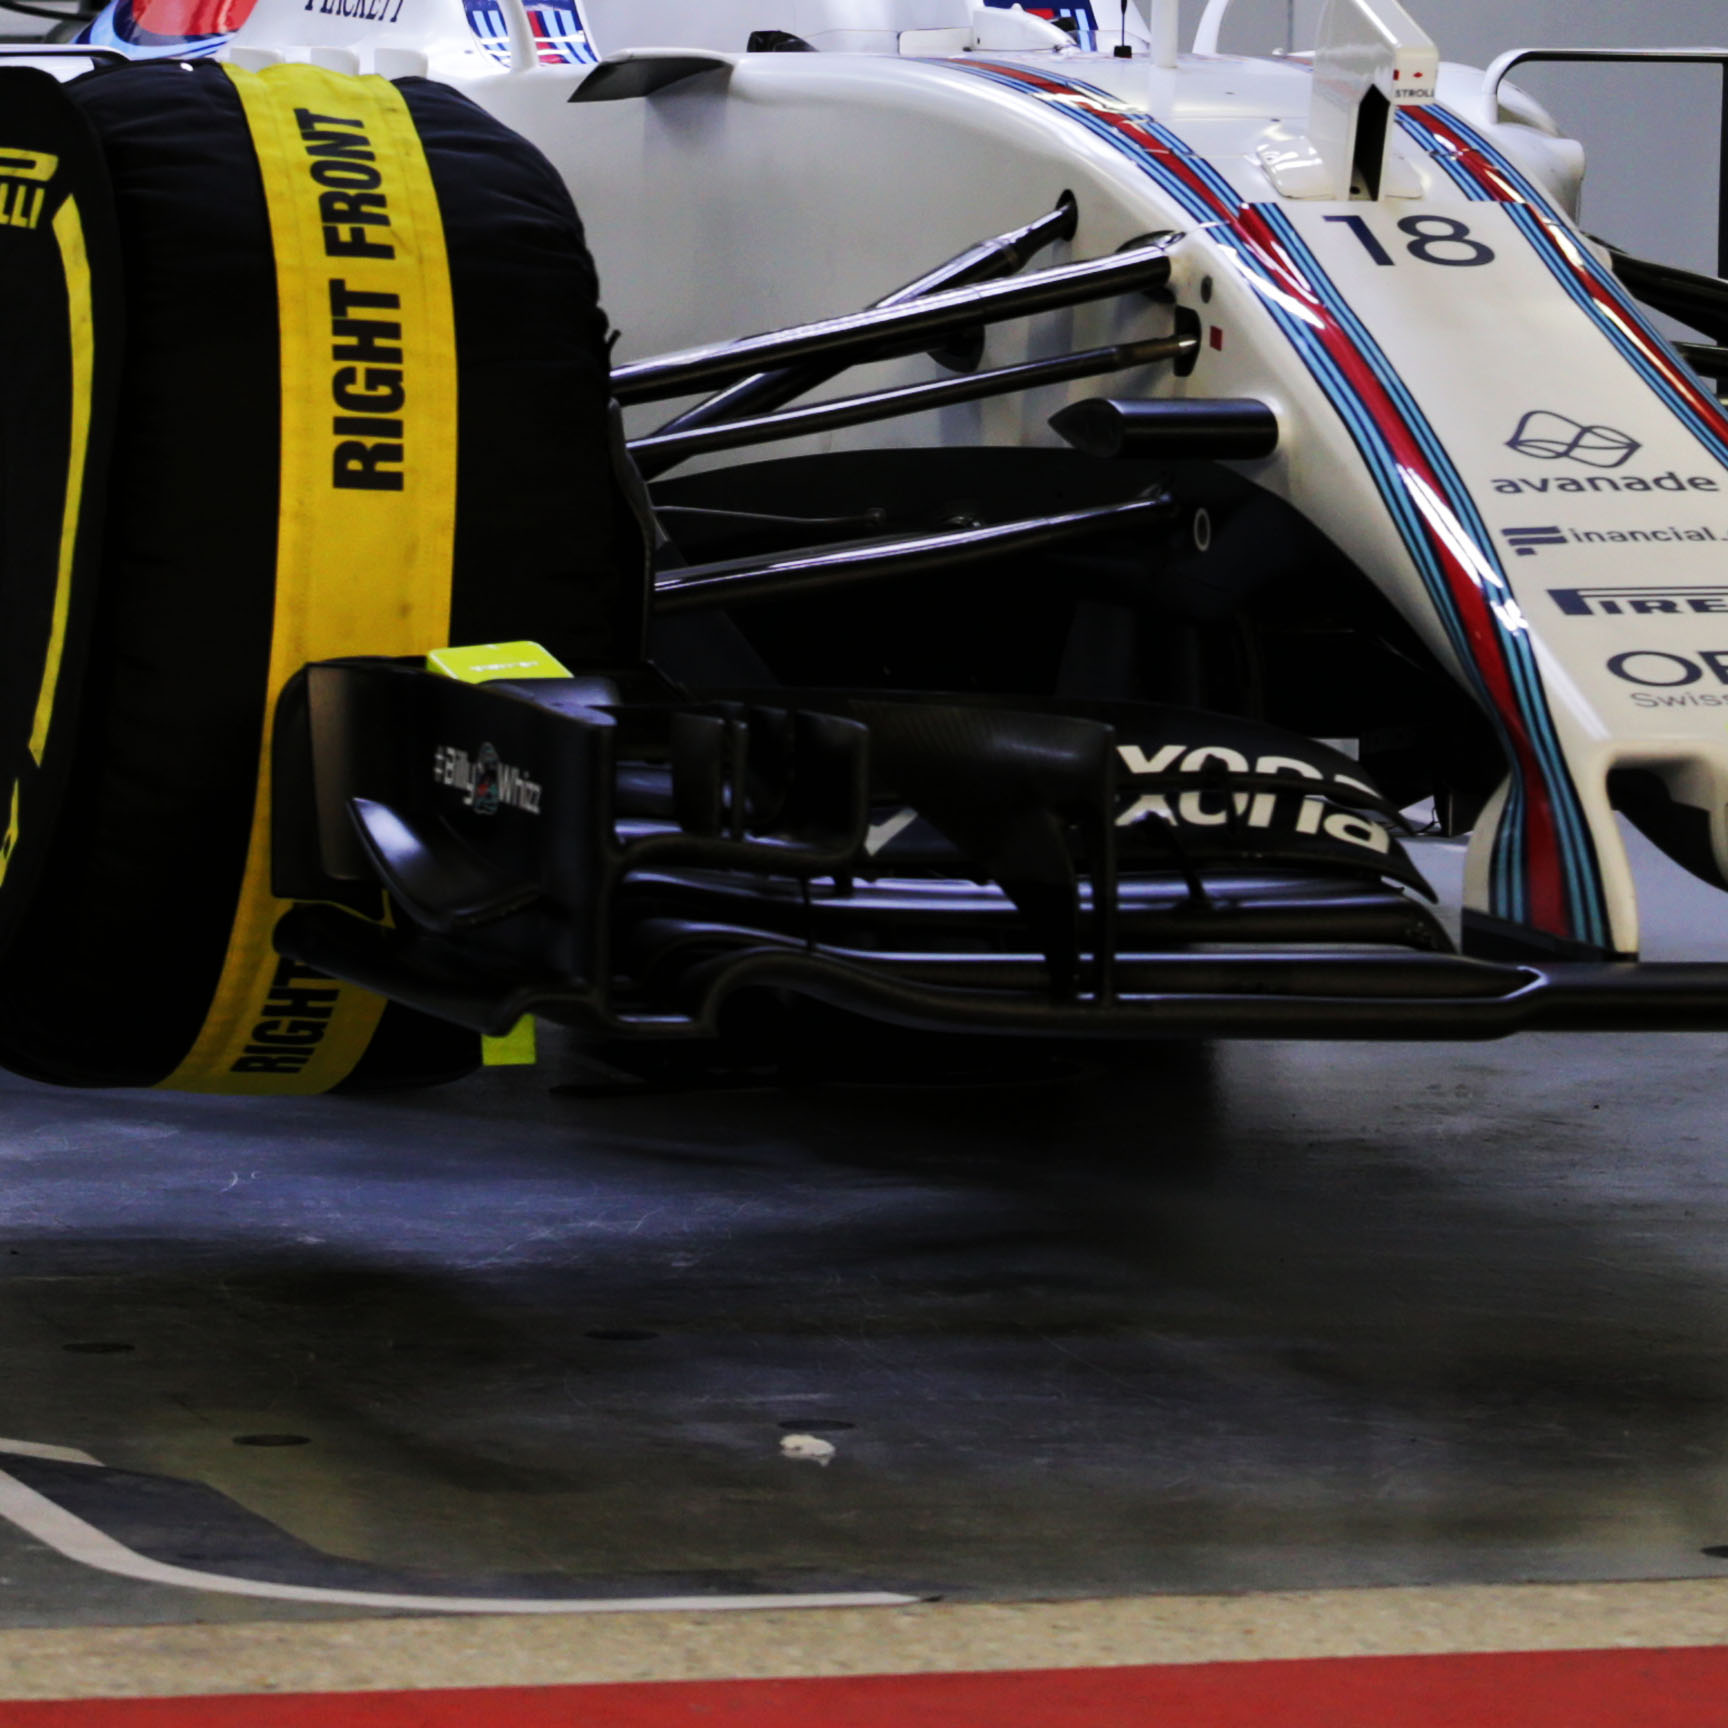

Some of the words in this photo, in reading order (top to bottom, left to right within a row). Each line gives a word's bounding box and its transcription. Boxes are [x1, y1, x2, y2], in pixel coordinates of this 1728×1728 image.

[293, 105, 397, 262] FRONT
[1322, 213, 1496, 268] 18
[329, 277, 406, 493] RIGHT
[1491, 471, 1720, 496] avanade
[1114, 744, 1391, 854] xona
